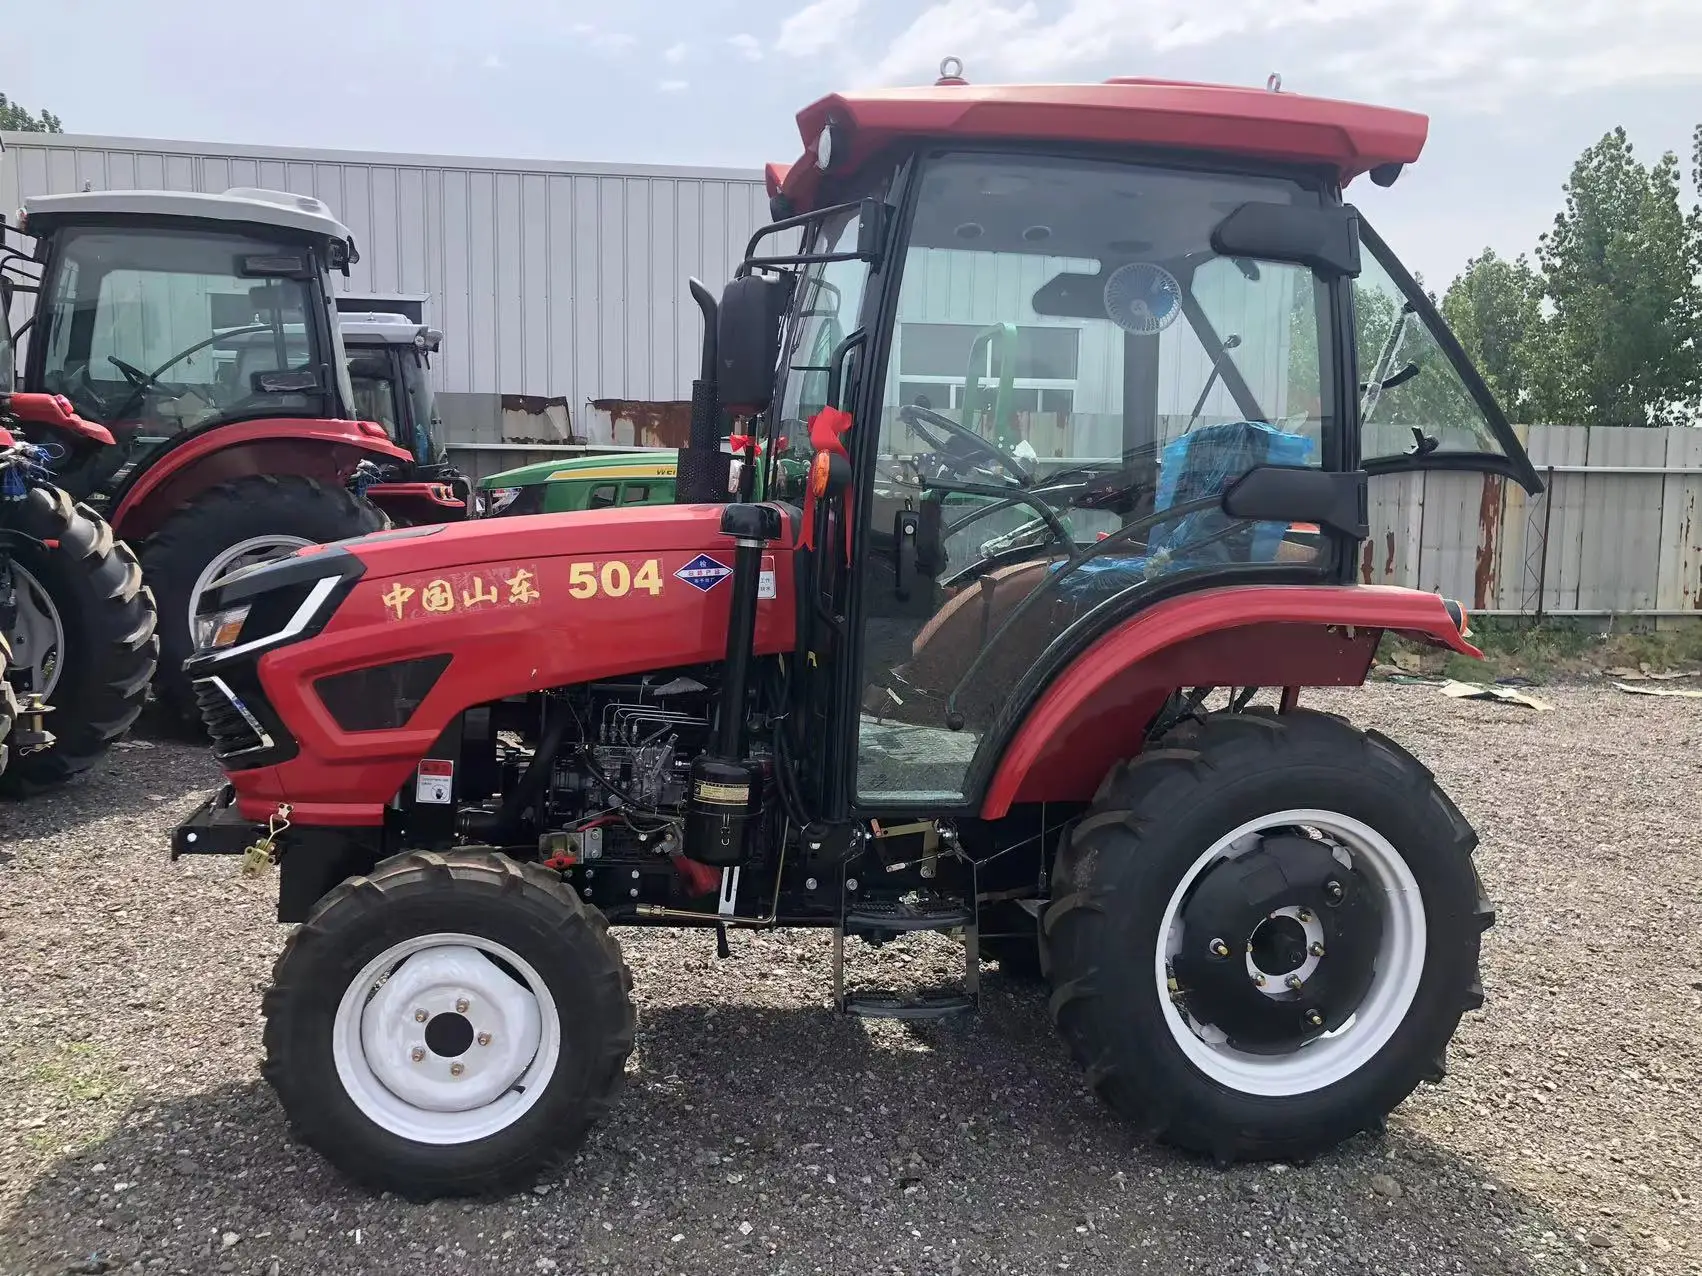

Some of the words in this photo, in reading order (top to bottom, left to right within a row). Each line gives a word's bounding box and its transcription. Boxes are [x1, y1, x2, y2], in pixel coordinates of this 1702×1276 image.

[382, 569, 540, 619] 中国山东
[568, 559, 663, 599] 504
